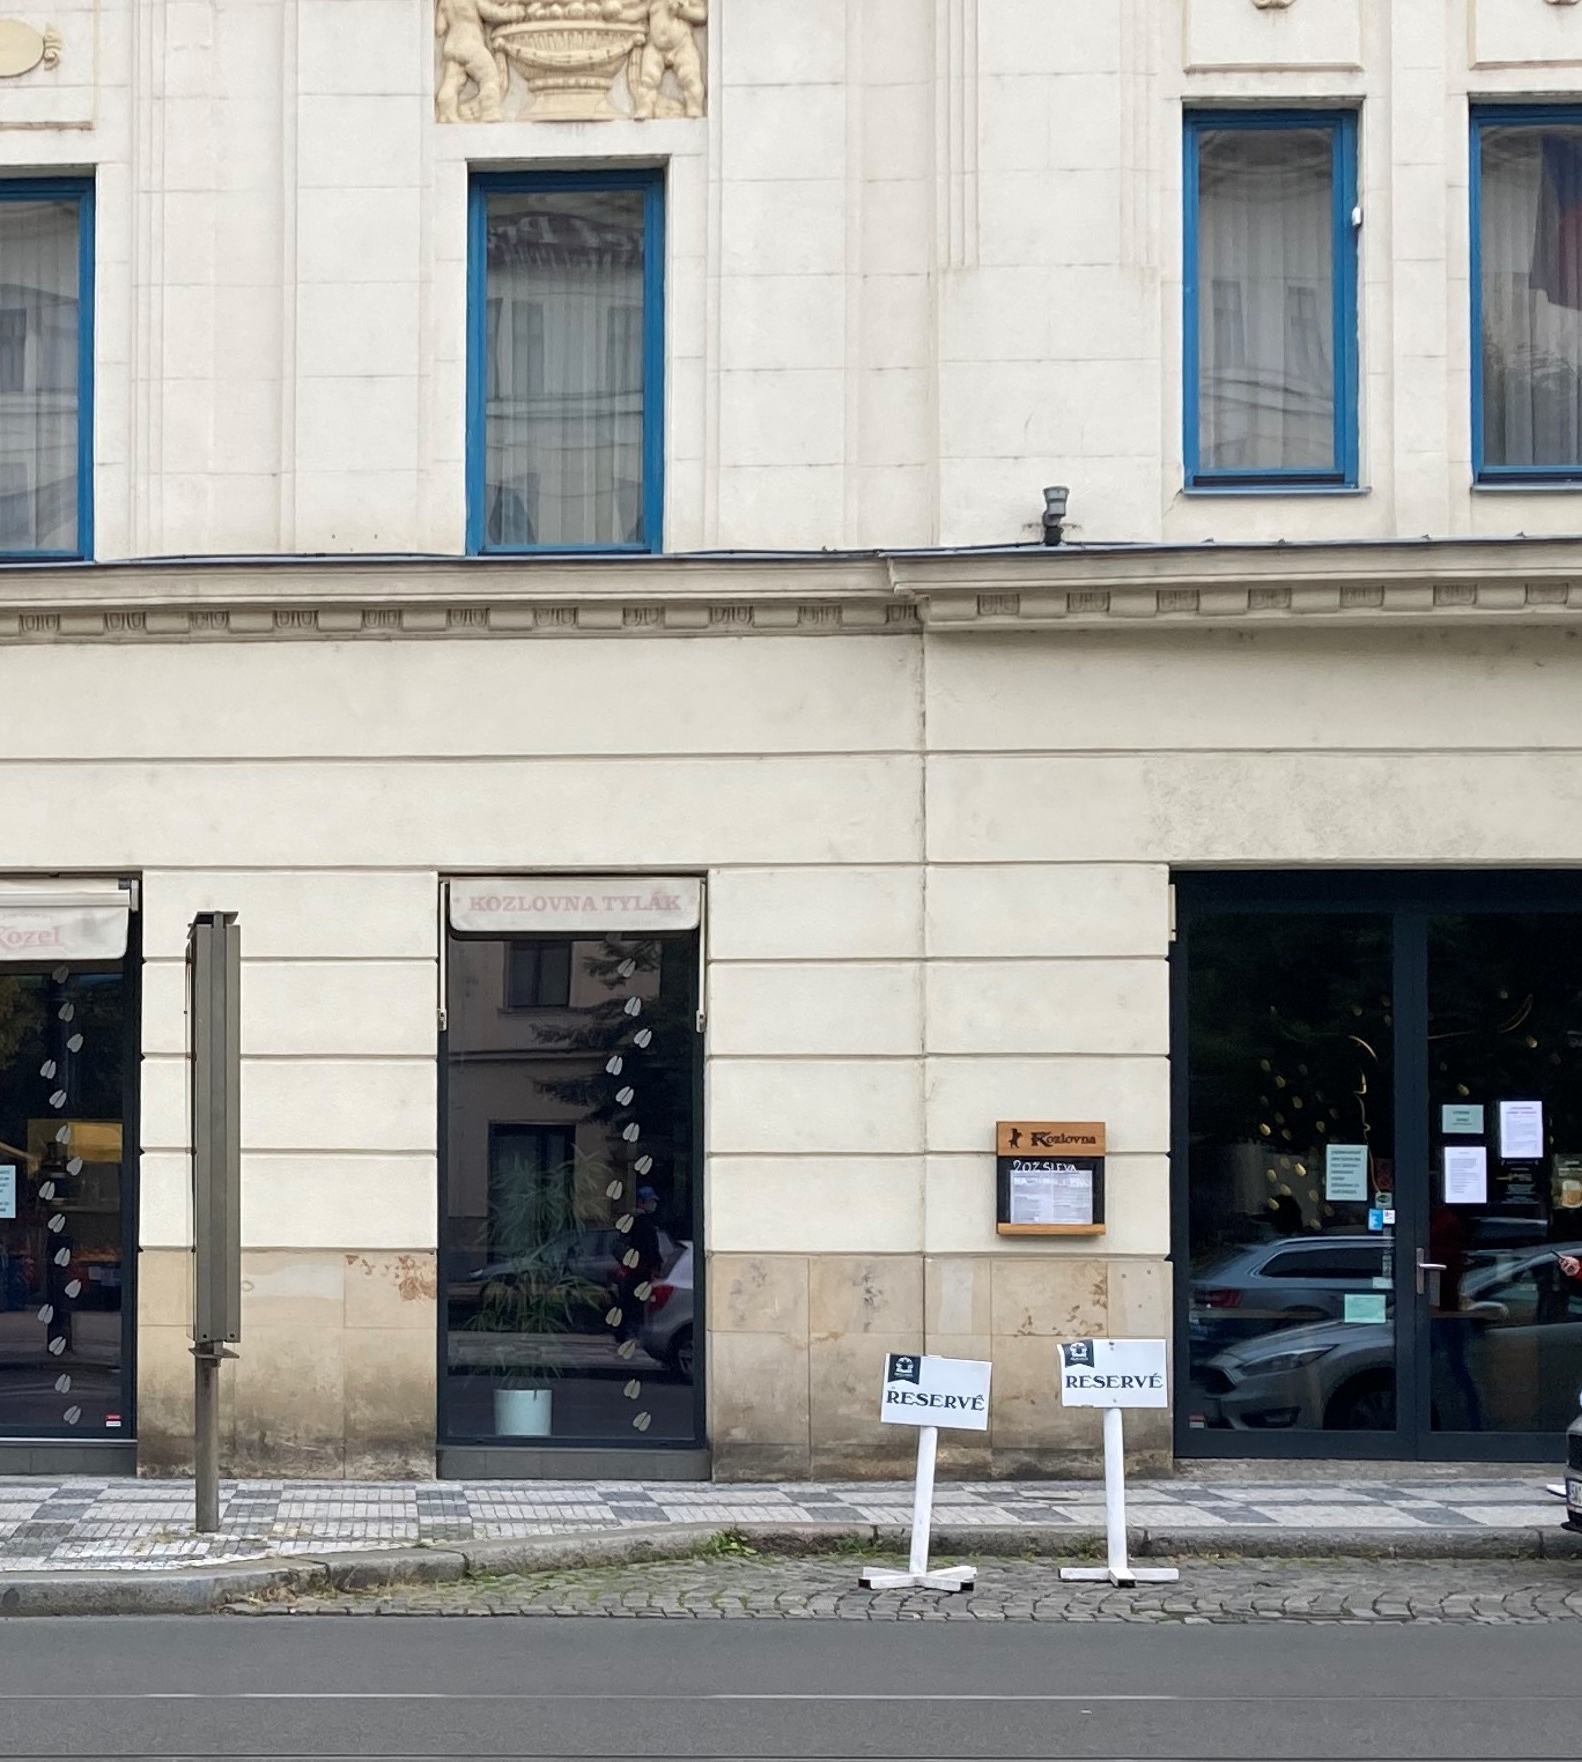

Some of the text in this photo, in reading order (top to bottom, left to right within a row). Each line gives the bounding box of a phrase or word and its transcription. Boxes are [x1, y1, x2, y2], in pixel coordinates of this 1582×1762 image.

[468, 890, 681, 914] KOZLOVNA TYLÁK
[1030, 1131, 1096, 1148] Kozlovna
[1064, 1372, 1164, 1390] RESERVÉ
[886, 1388, 986, 1411] RESERVÉ
